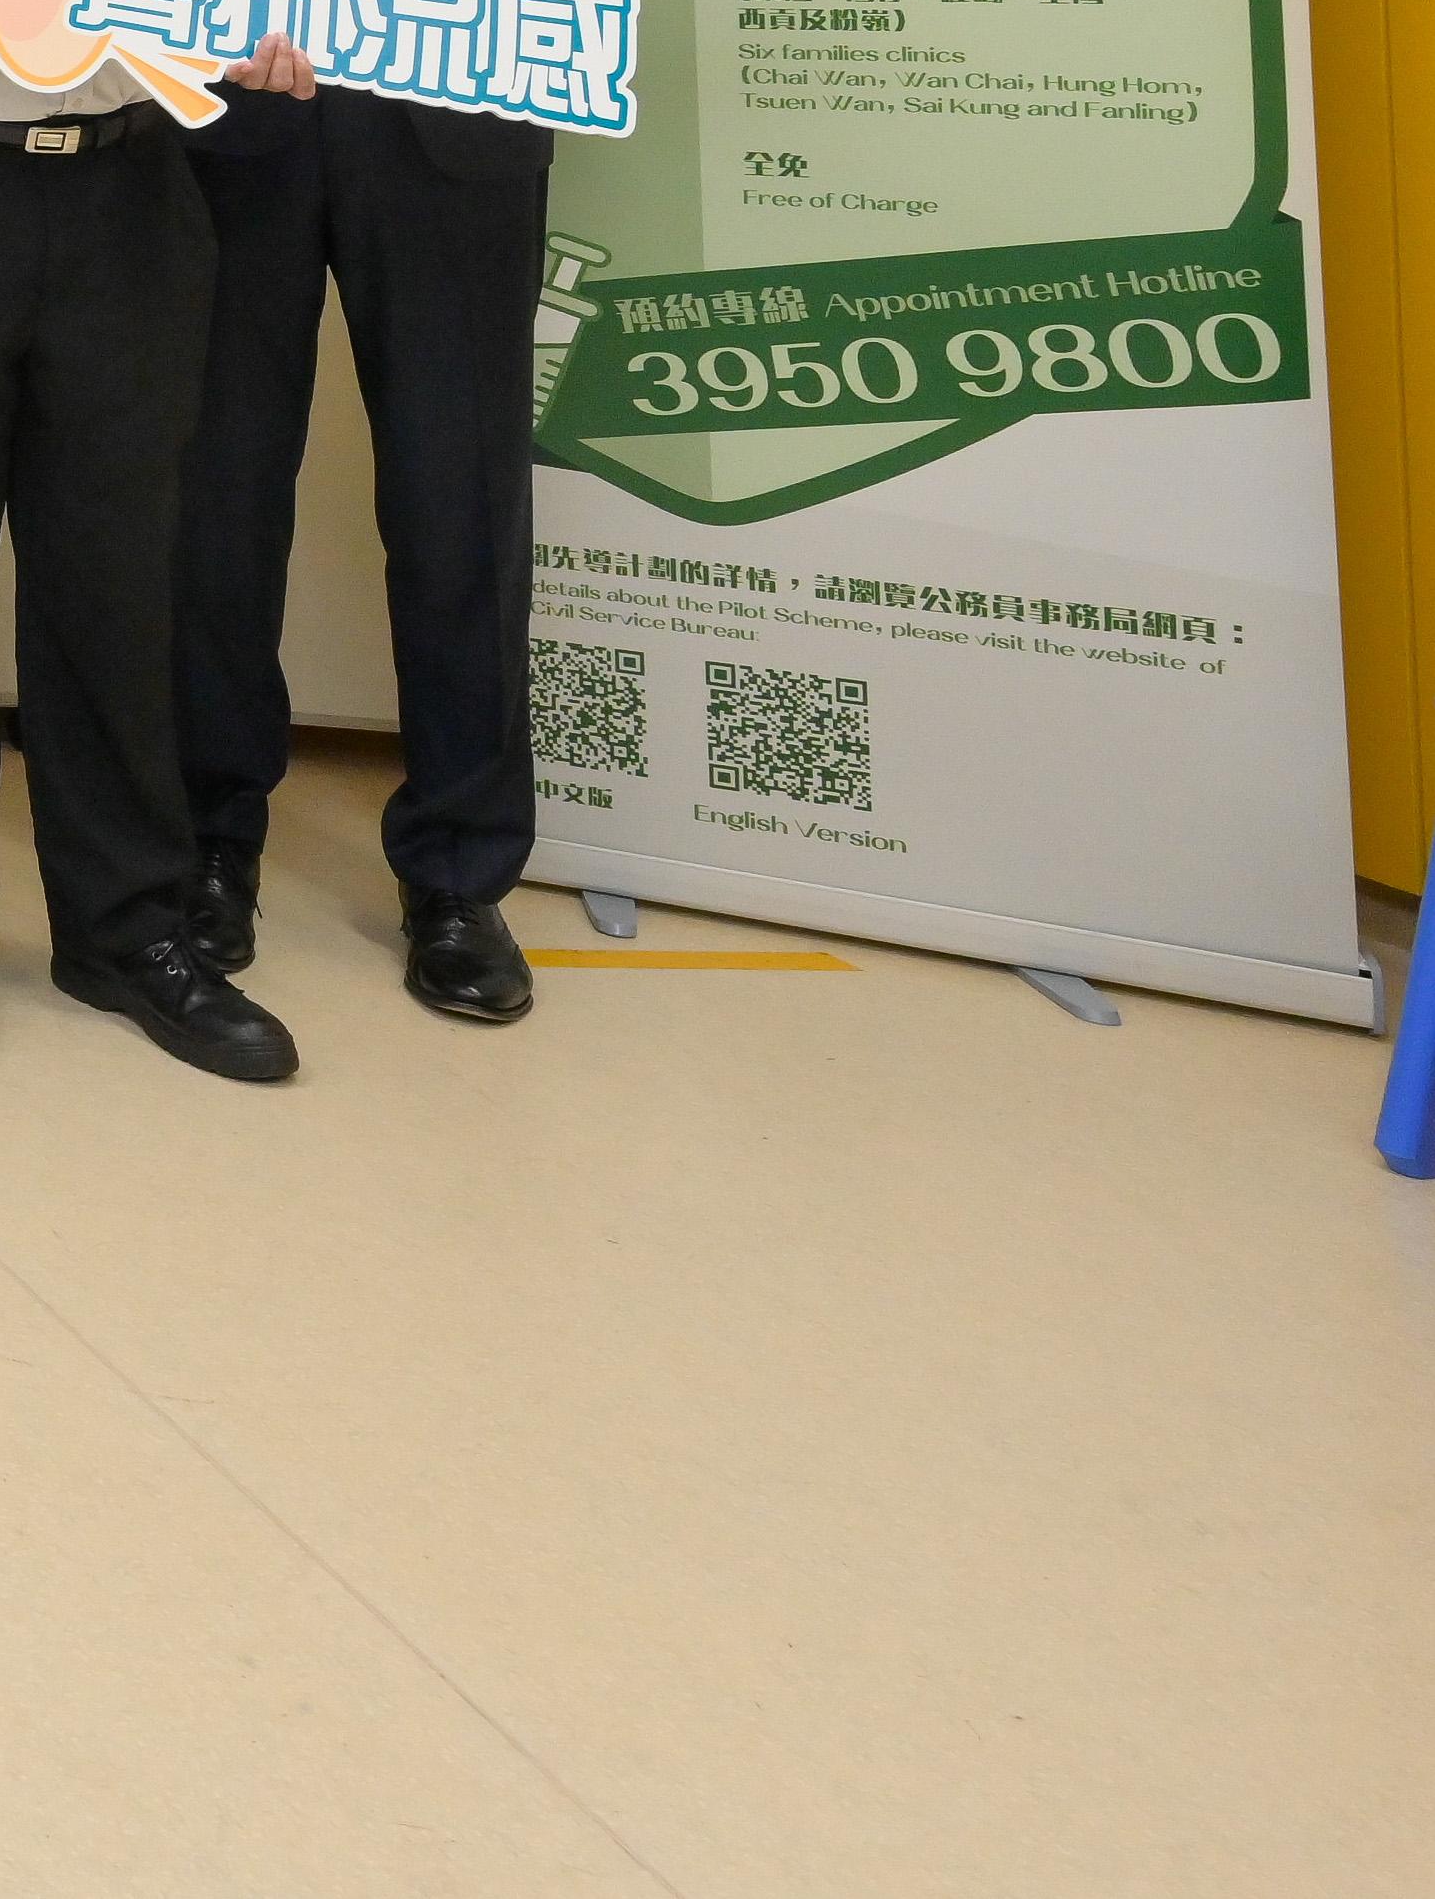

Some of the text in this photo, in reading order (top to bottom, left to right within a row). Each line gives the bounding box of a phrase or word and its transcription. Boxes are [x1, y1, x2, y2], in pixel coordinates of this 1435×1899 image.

[738, 43, 967, 64] Six families clinics
[741, 65, 1203, 98] (Chai Wan, Wan Chai, Hung Hom,
[740, 91, 1199, 126] Tsuen Wan, Sai Kung and Fanling)
[742, 149, 810, 179] 全免
[742, 189, 939, 217] Free of Charge
[614, 263, 1263, 335] 預約專線 Appointment Hotline
[626, 311, 1282, 418] 3950 9800
[530, 600, 760, 643] Civil Service Bureau:
[533, 579, 1228, 675] details about the Pilot Scheme, please visit the website of
[536, 778, 614, 810] 中文版
[693, 803, 908, 854] English Version
